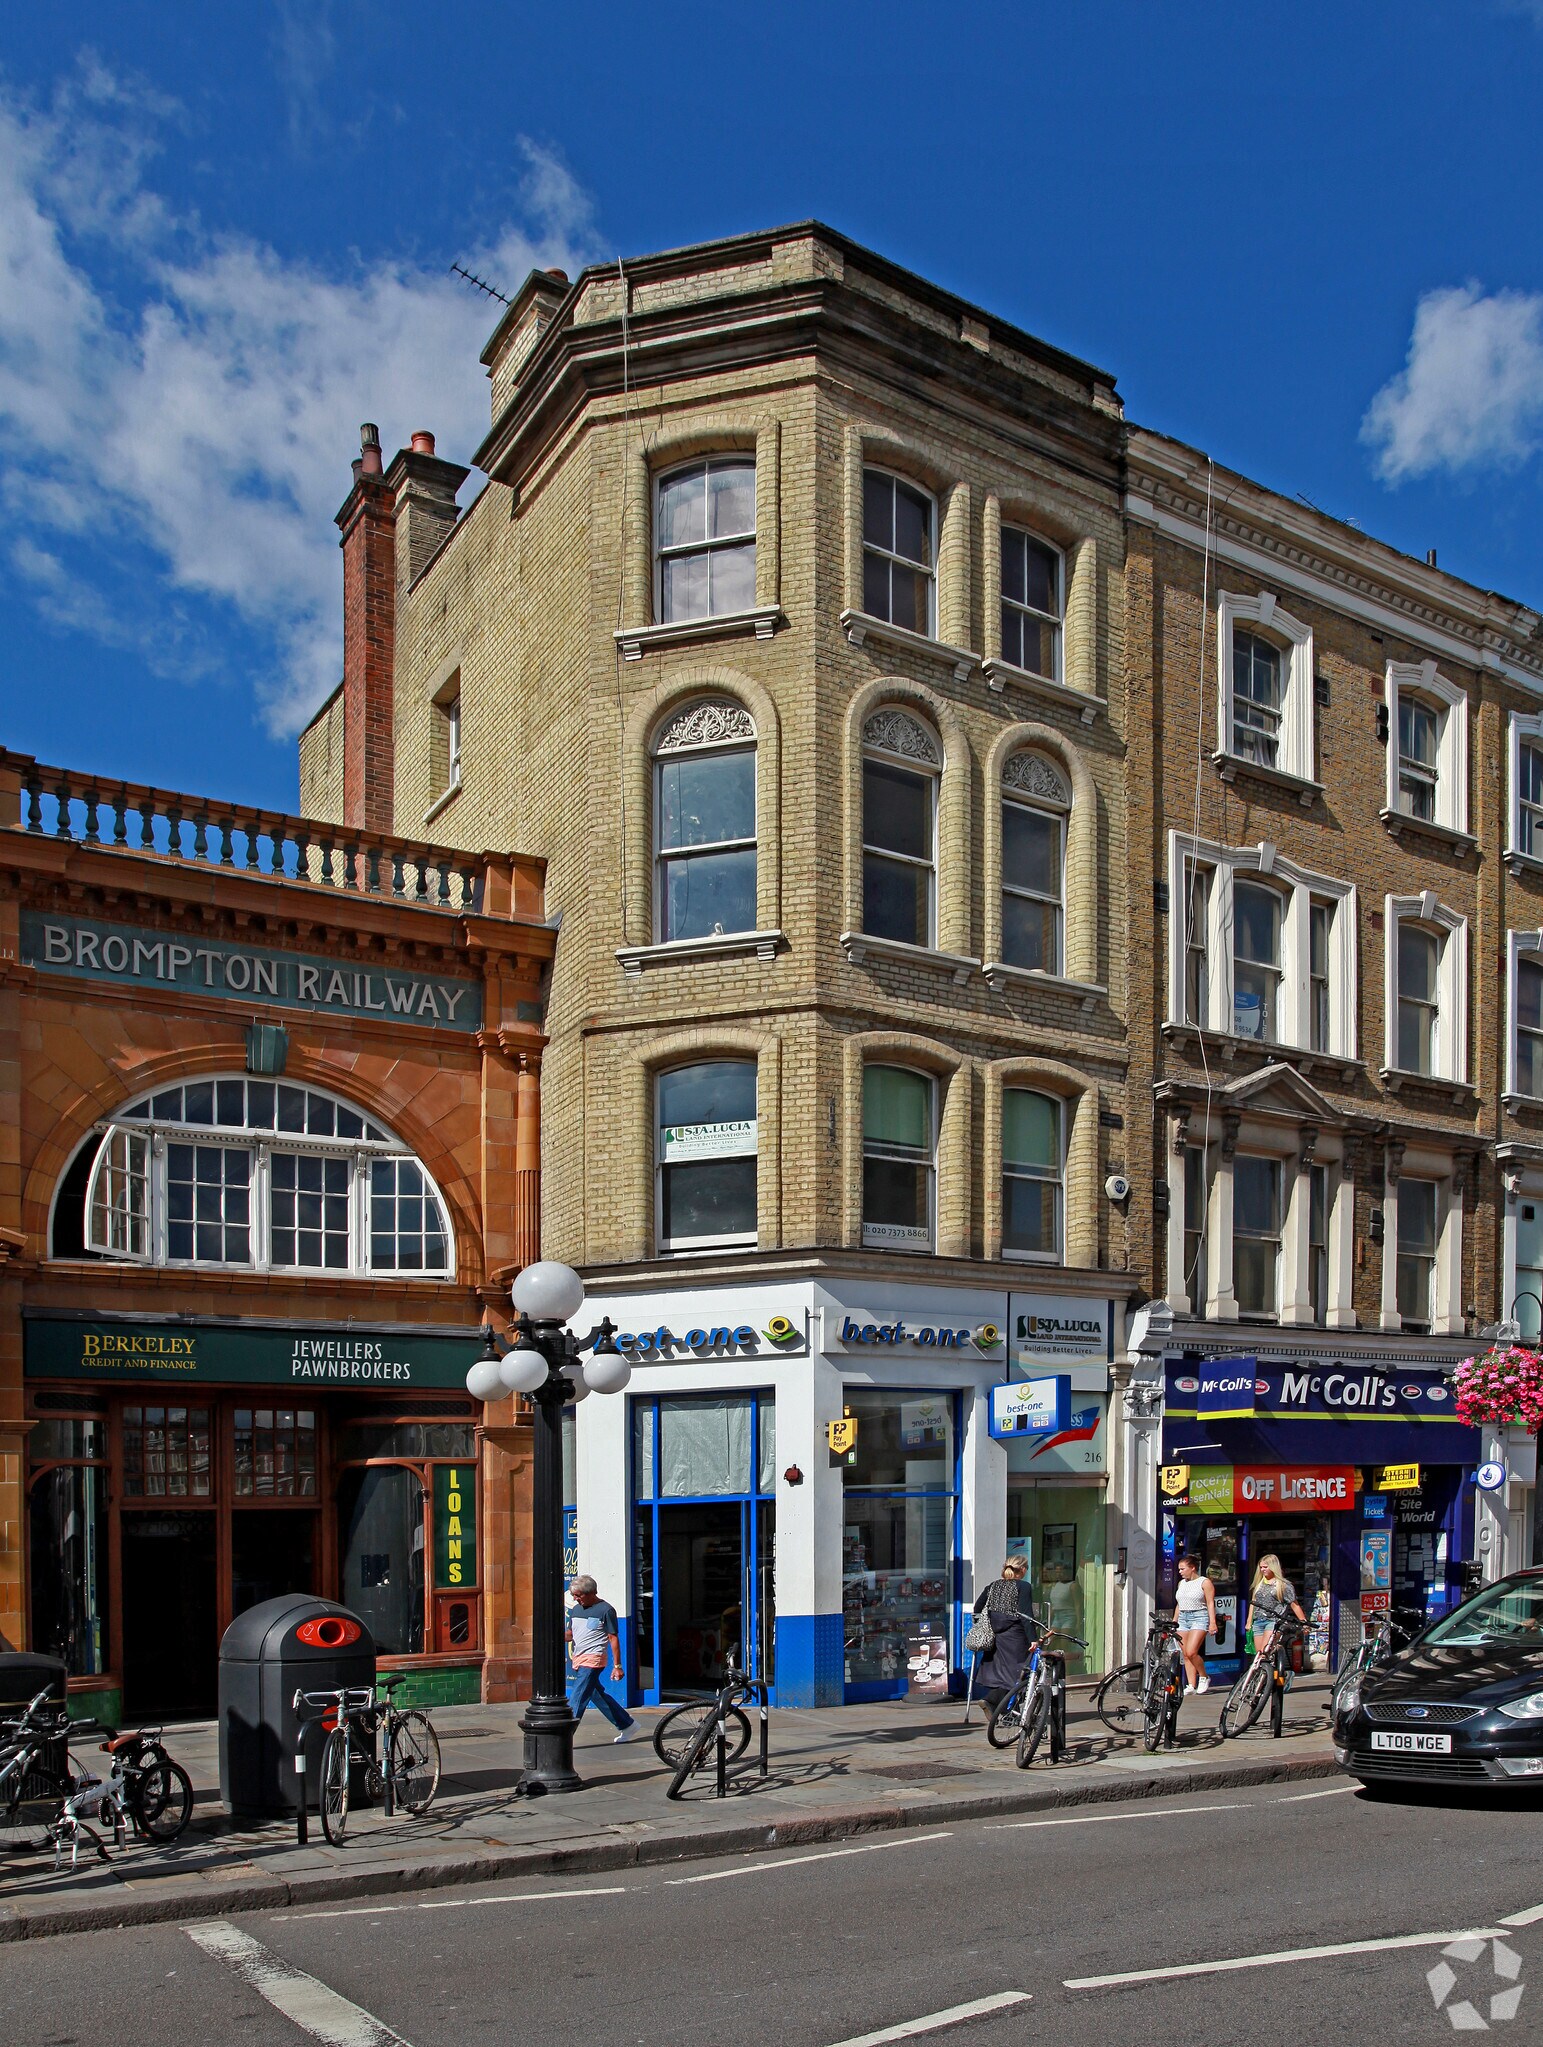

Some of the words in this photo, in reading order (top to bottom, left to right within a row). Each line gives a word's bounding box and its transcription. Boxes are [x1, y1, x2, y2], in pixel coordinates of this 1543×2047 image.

[43, 925, 278, 996] BROMPTON
[298, 964, 465, 1021] RAILWAY
[888, 1228, 905, 1237] 7373
[907, 1229, 926, 1237] 8866
[842, 1316, 970, 1348] best-one
[83, 1335, 196, 1356] BERKELEY
[291, 1340, 382, 1360] JEWELLERS
[1024, 1345, 1051, 1353] Building
[81, 1357, 122, 1367] CREDIT
[124, 1359, 148, 1368] AND
[149, 1359, 197, 1369] FINANCE
[292, 1360, 411, 1380] PAWNBROKERS
[1007, 1401, 1044, 1413] best-one
[1084, 1452, 1102, 1463] 216
[1385, 1473, 1410, 1481] UNION
[1241, 1475, 1275, 1500] OFF
[1280, 1473, 1346, 1500] LICENCE
[1400, 1499, 1422, 1510] Site
[1364, 1508, 1385, 1516] Ticket
[1401, 1511, 1436, 1523] World
[448, 1469, 462, 1583] LOANS
[1373, 1595, 1387, 1608] £3
[1416, 1736, 1444, 1750] WGE
